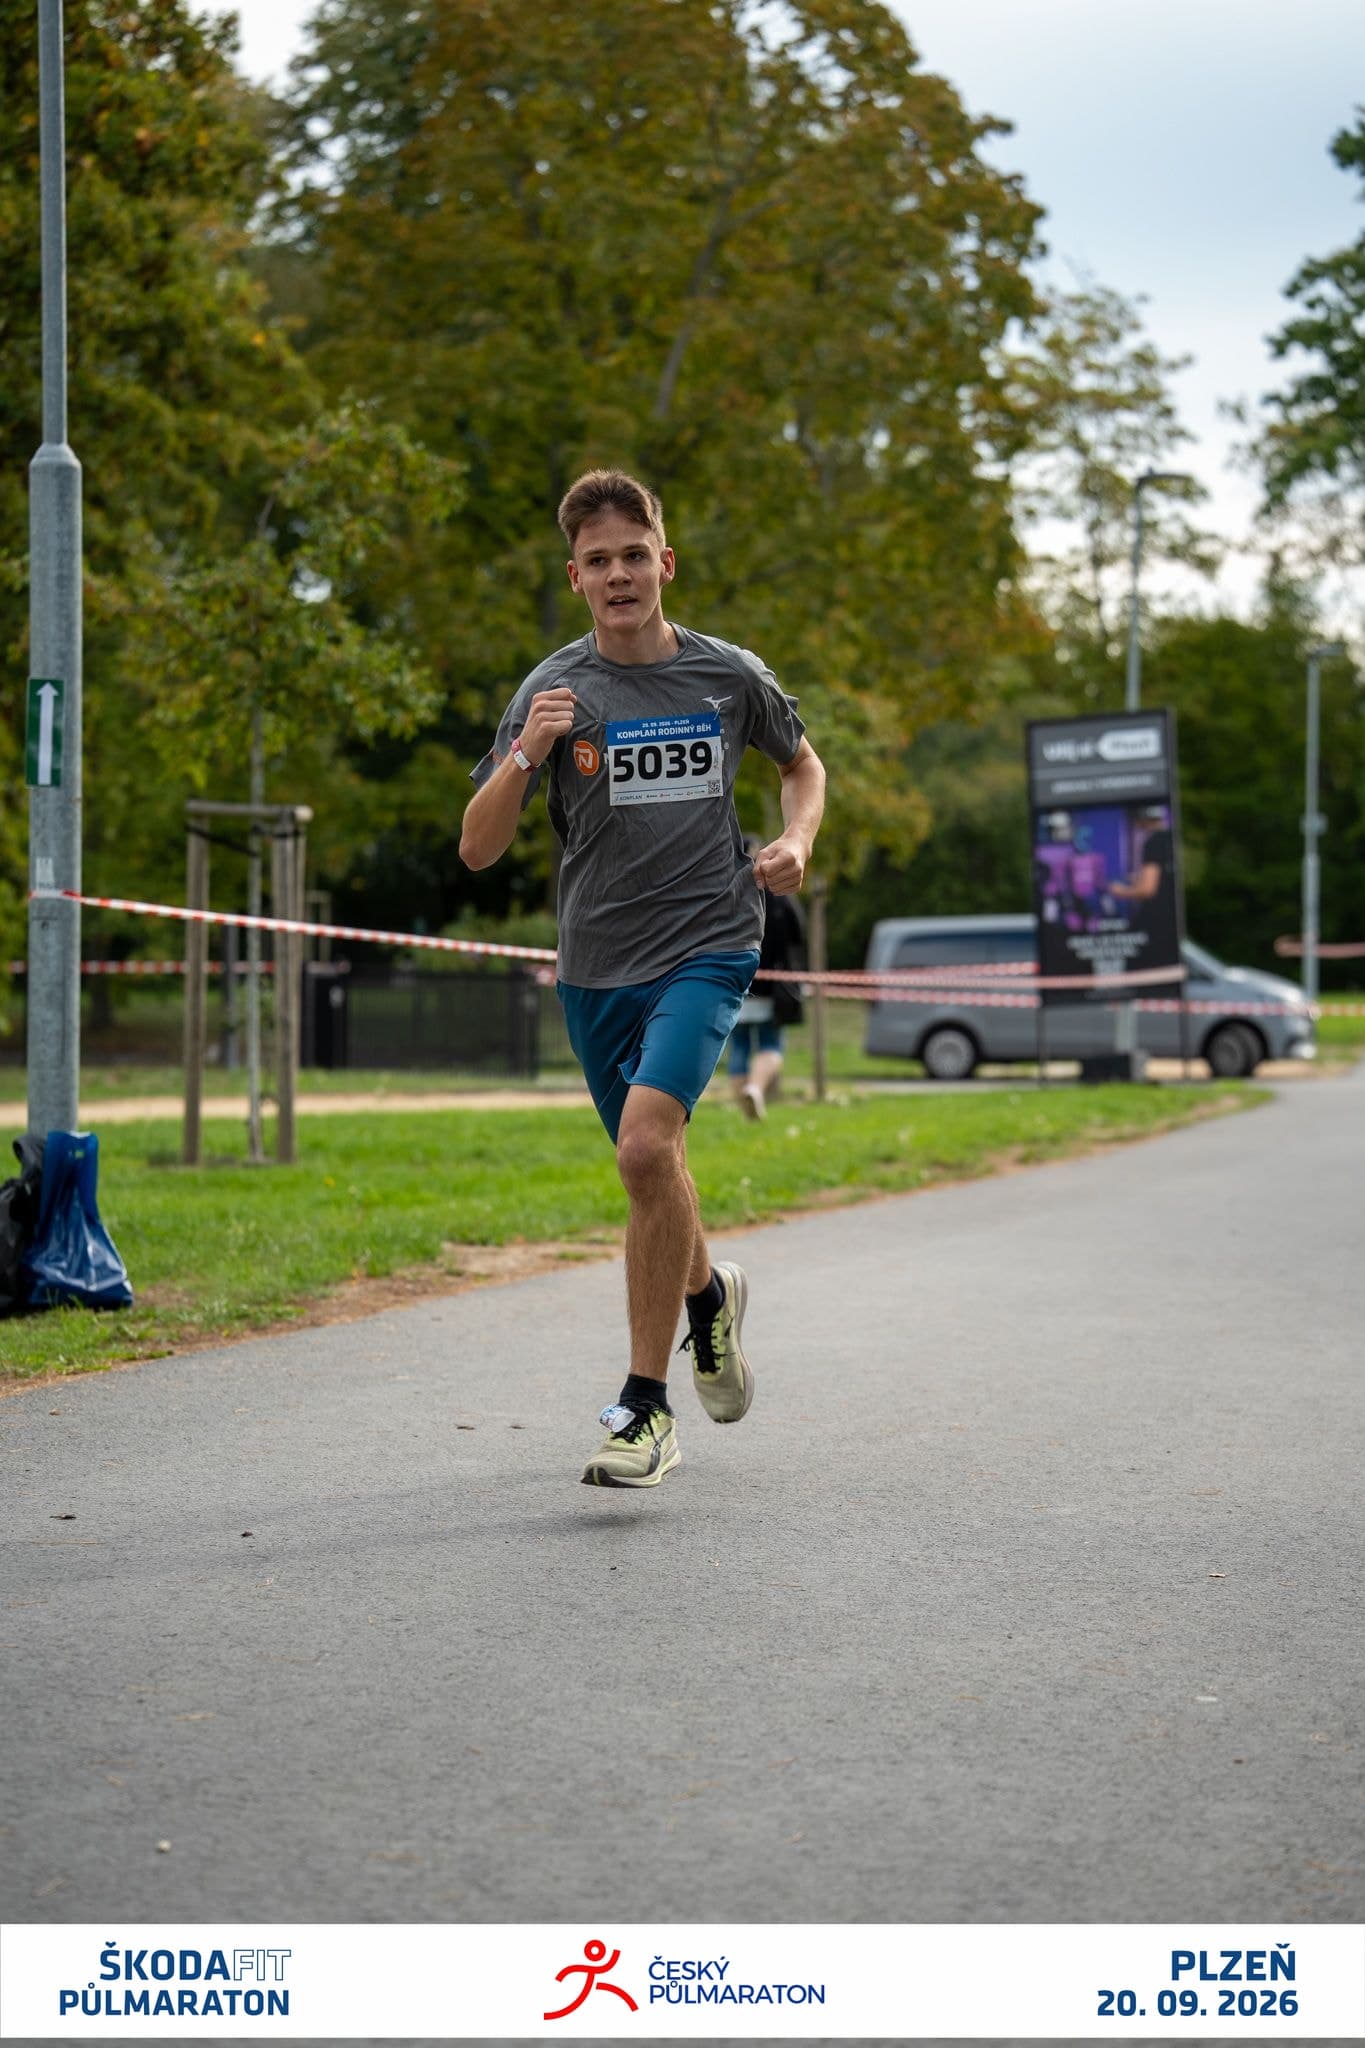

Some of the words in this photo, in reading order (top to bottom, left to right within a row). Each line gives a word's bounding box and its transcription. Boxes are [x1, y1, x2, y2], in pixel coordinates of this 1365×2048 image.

[617, 728, 656, 739] KONPLAN
[658, 724, 695, 736] RODINNÝ
[696, 723, 712, 733] BĚH
[613, 741, 712, 783] 5039
